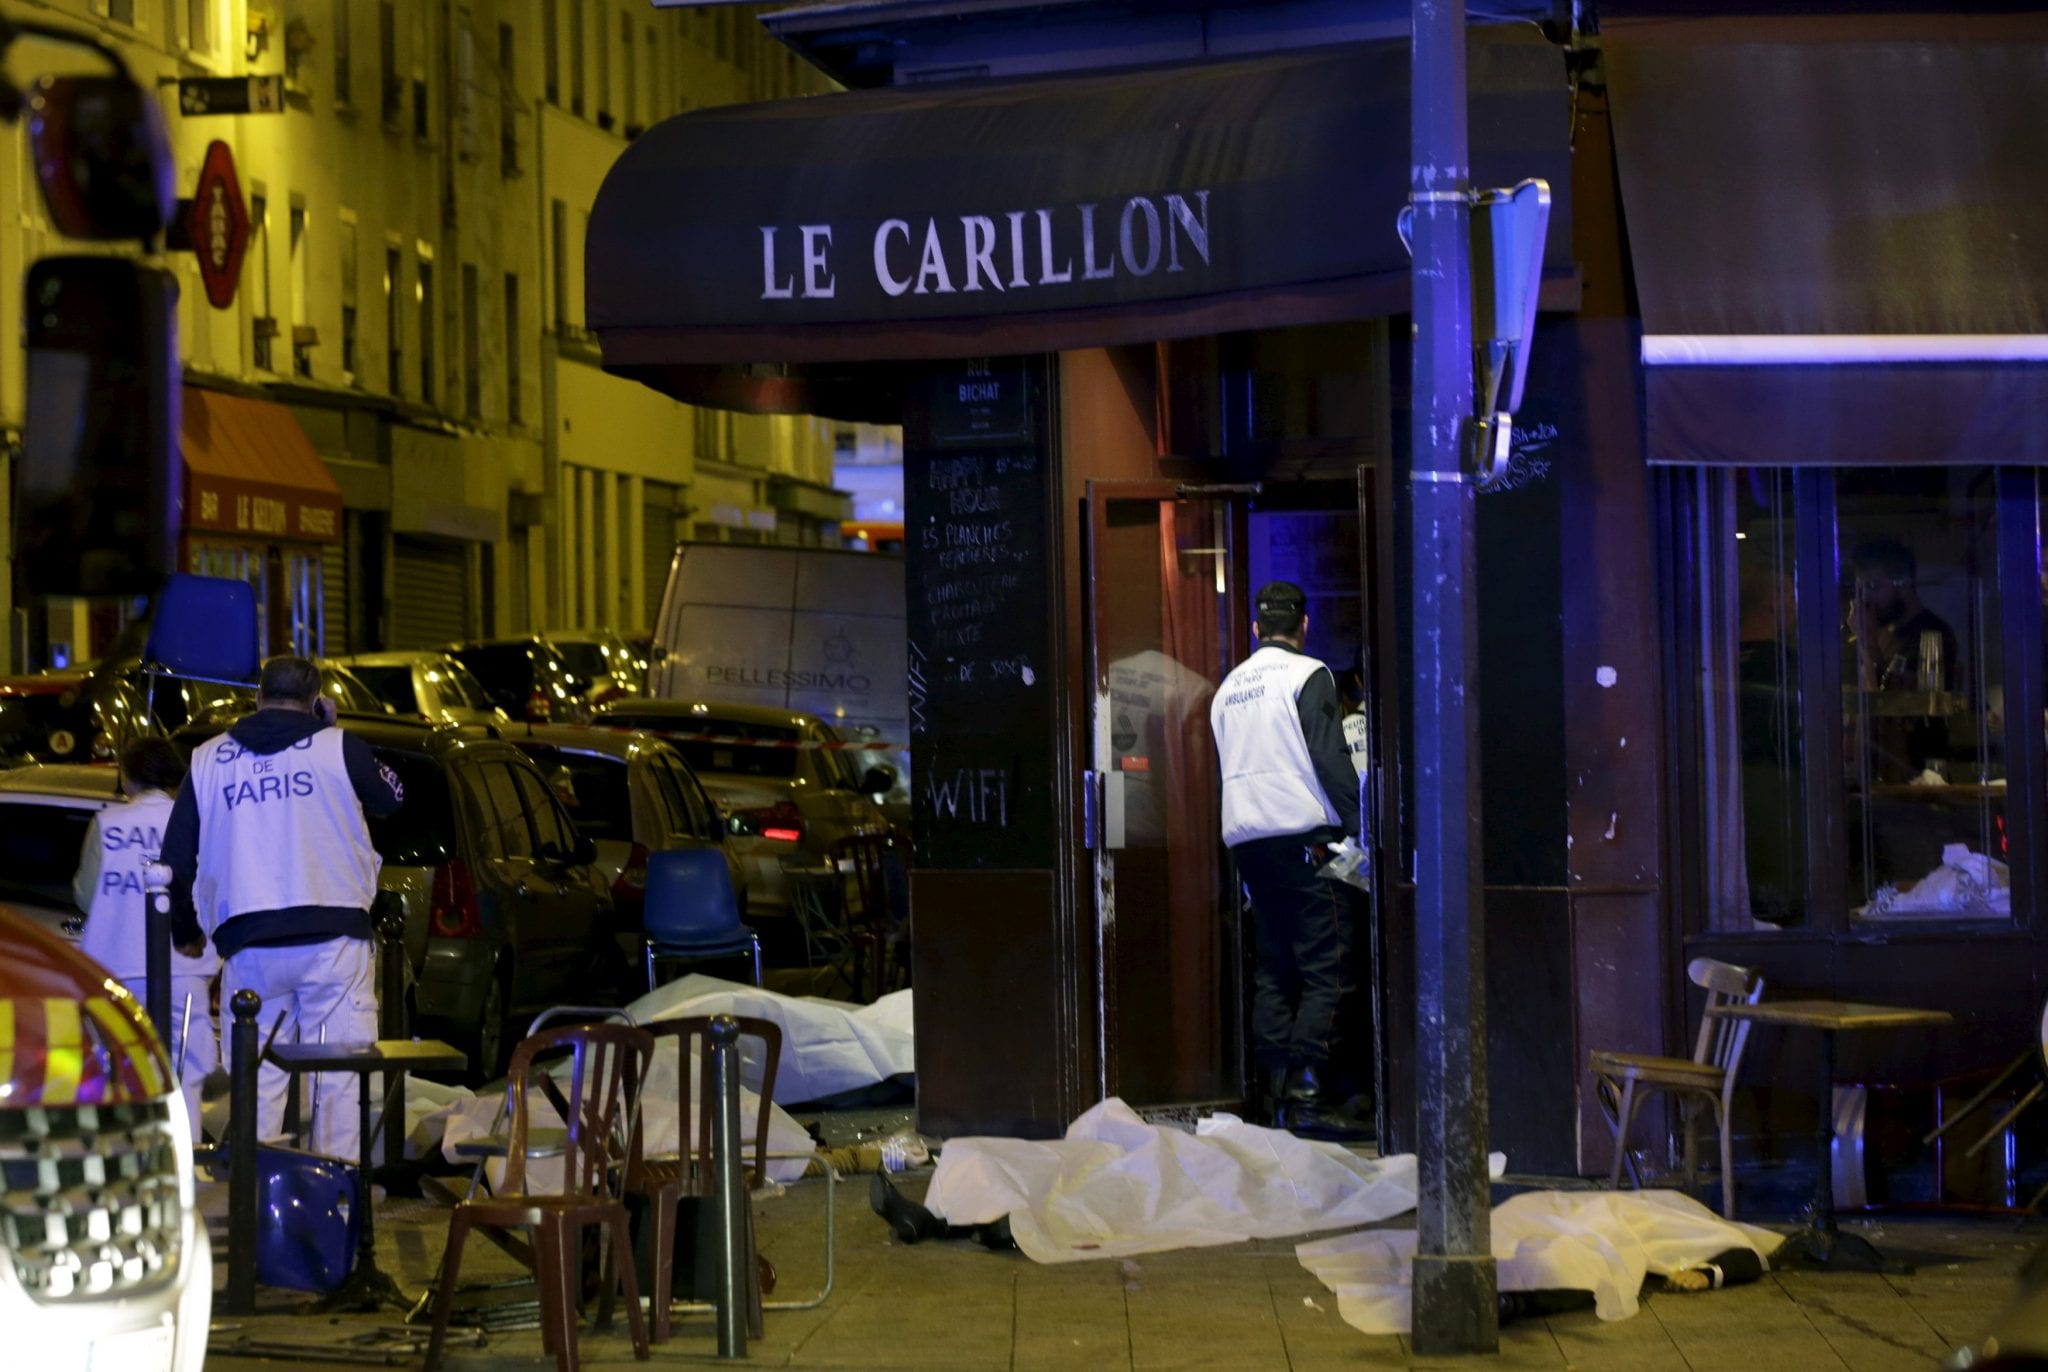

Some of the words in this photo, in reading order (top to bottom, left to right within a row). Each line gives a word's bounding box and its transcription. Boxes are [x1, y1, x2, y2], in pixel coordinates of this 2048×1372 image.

[212, 186, 226, 266] TABAC
[758, 224, 835, 299] LE
[873, 189, 1210, 297] CARILLON
[958, 381, 1001, 402] BICHAT
[706, 664, 872, 692] PELLESSIMO
[216, 735, 312, 763] SAU
[253, 760, 273, 774] DE
